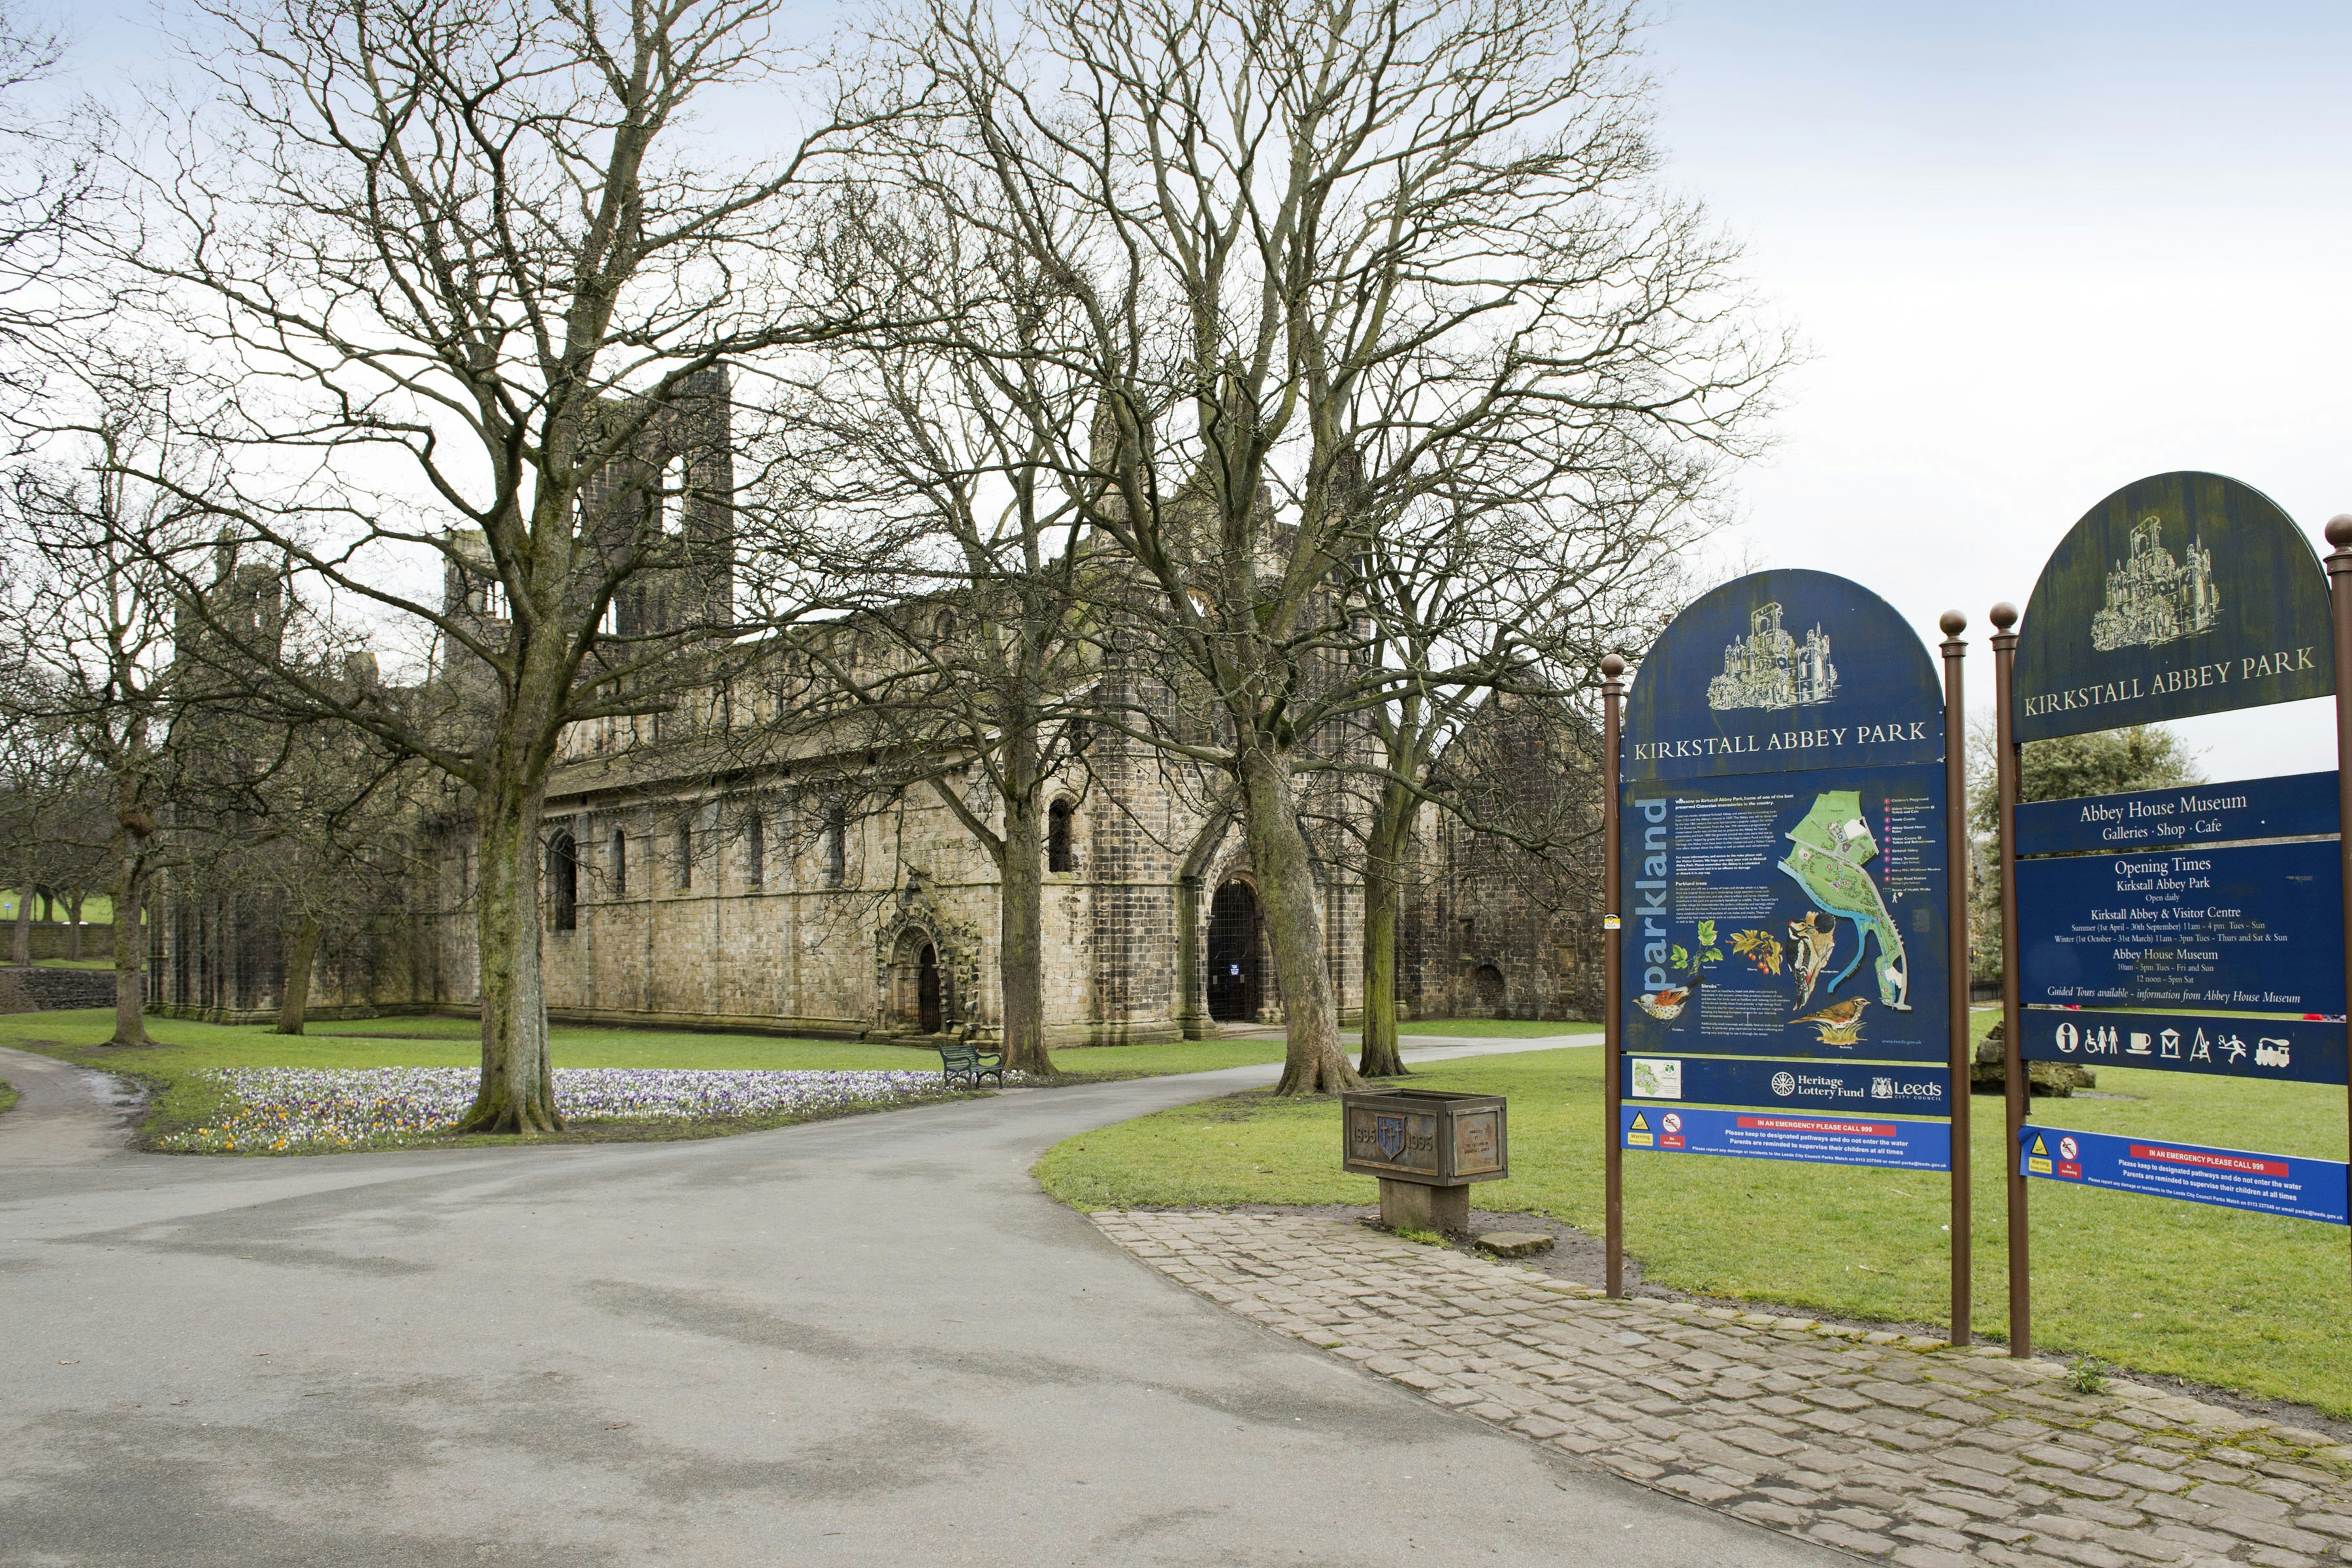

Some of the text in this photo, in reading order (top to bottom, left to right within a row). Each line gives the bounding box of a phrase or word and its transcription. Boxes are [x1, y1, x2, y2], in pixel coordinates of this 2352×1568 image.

[2025, 647, 2315, 716] KIRKSTALL ABBEY PARK
[1635, 722, 1926, 760] KIRKSTALL ABBEY PARK
[2080, 796, 2247, 824] Abbey House Museum
[2103, 818, 2221, 840] Galleries Shop Cafe
[2115, 857, 2211, 877] Opening Times
[2117, 877, 2210, 891] Kirkstall Abbey Park
[1635, 799, 1676, 990] parkland
[2146, 893, 2180, 904] Open daily
[2091, 907, 2241, 921] Kirkstall Abbey & Visitor Centre
[2109, 923, 2125, 933] April
[2131, 923, 2146, 931] 30th
[2148, 923, 2181, 932] September)
[2132, 934, 2153, 943] March)
[2179, 934, 2193, 944] 3pm
[2239, 933, 2251, 941] and
[2113, 949, 2218, 962] Abbey House Museum
[2140, 963, 2153, 973] 5pm
[2168, 975, 2182, 985] 5pm
[2048, 987, 2300, 1004] Guided Tours available information from Abbey House Museum
[1798, 1075, 1843, 1089] Heritage
[1895, 1082, 1942, 1096] Leeds
[1798, 1086, 1864, 1099] Lottery Fund
[2166, 1152, 2206, 1162] EMERGENCY
[2207, 1157, 2232, 1166] PLEASE
[2234, 1160, 2251, 1169] CALL
[2119, 1159, 2136, 1168] Please
[2138, 1162, 2151, 1171] keep
[2159, 1165, 2191, 1175] designated
[2191, 1171, 2219, 1180] pathways
[2123, 1169, 2144, 1179] Parents
[2155, 1176, 2182, 1184] reminded
[2190, 1181, 2219, 1190] supervise
[2235, 1186, 2261, 1196] children
[2279, 1192, 2297, 1201] times
